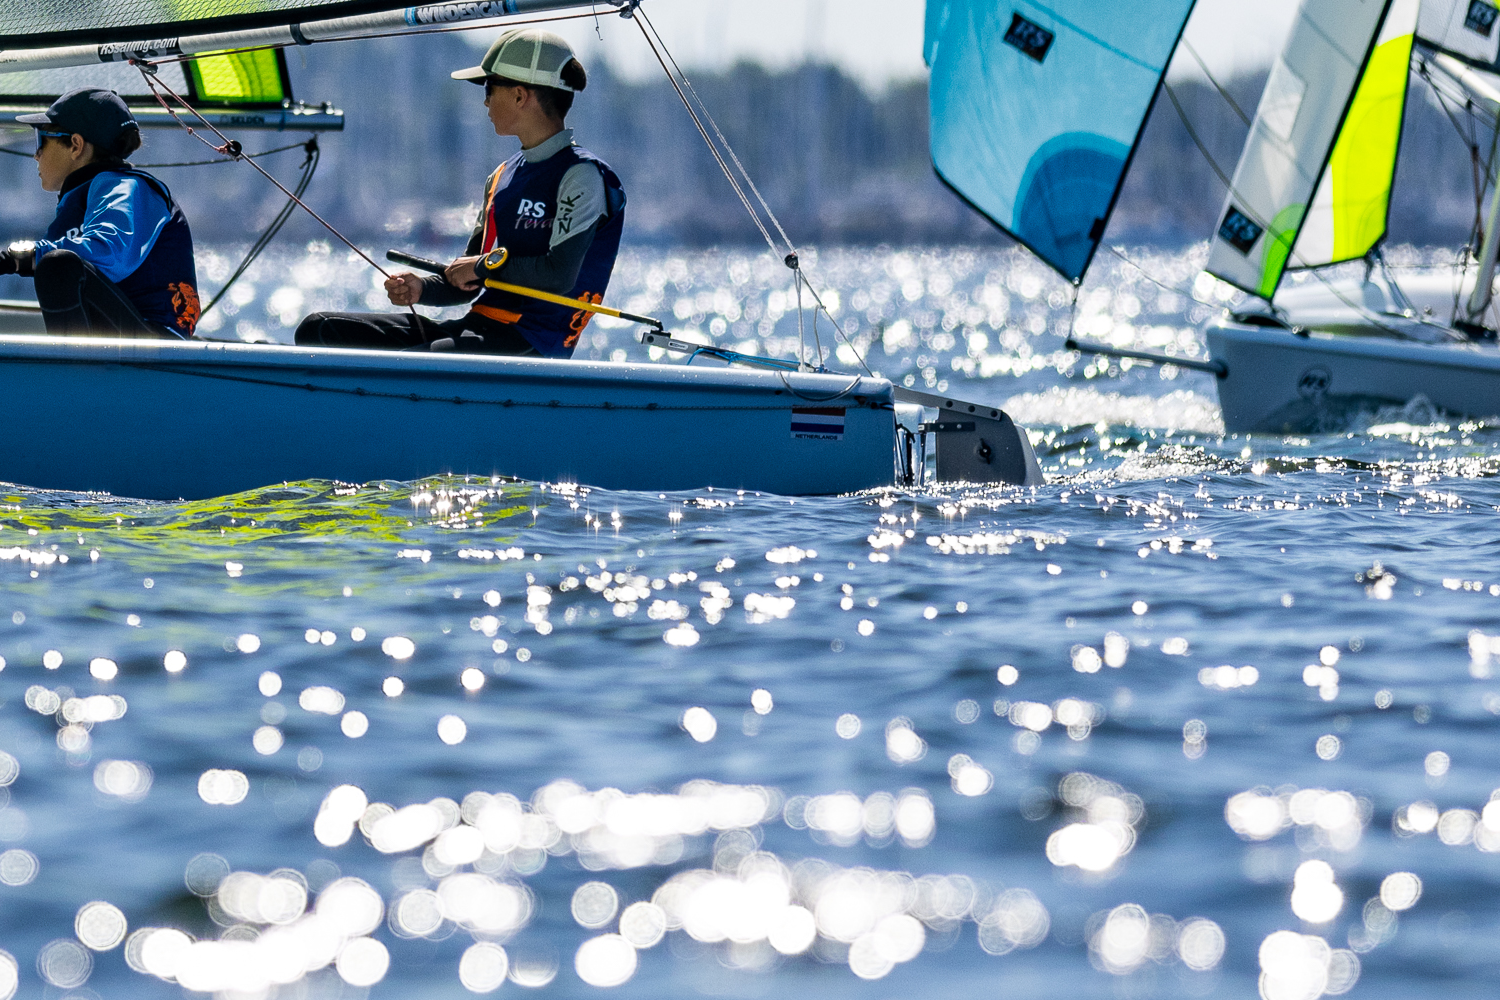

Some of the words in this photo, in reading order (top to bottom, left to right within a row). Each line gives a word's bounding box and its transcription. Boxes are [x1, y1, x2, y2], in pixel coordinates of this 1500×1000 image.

[1014, 20, 1051, 48] RS
[517, 198, 547, 219] RS
[795, 433, 838, 441] NETHERLANDS
